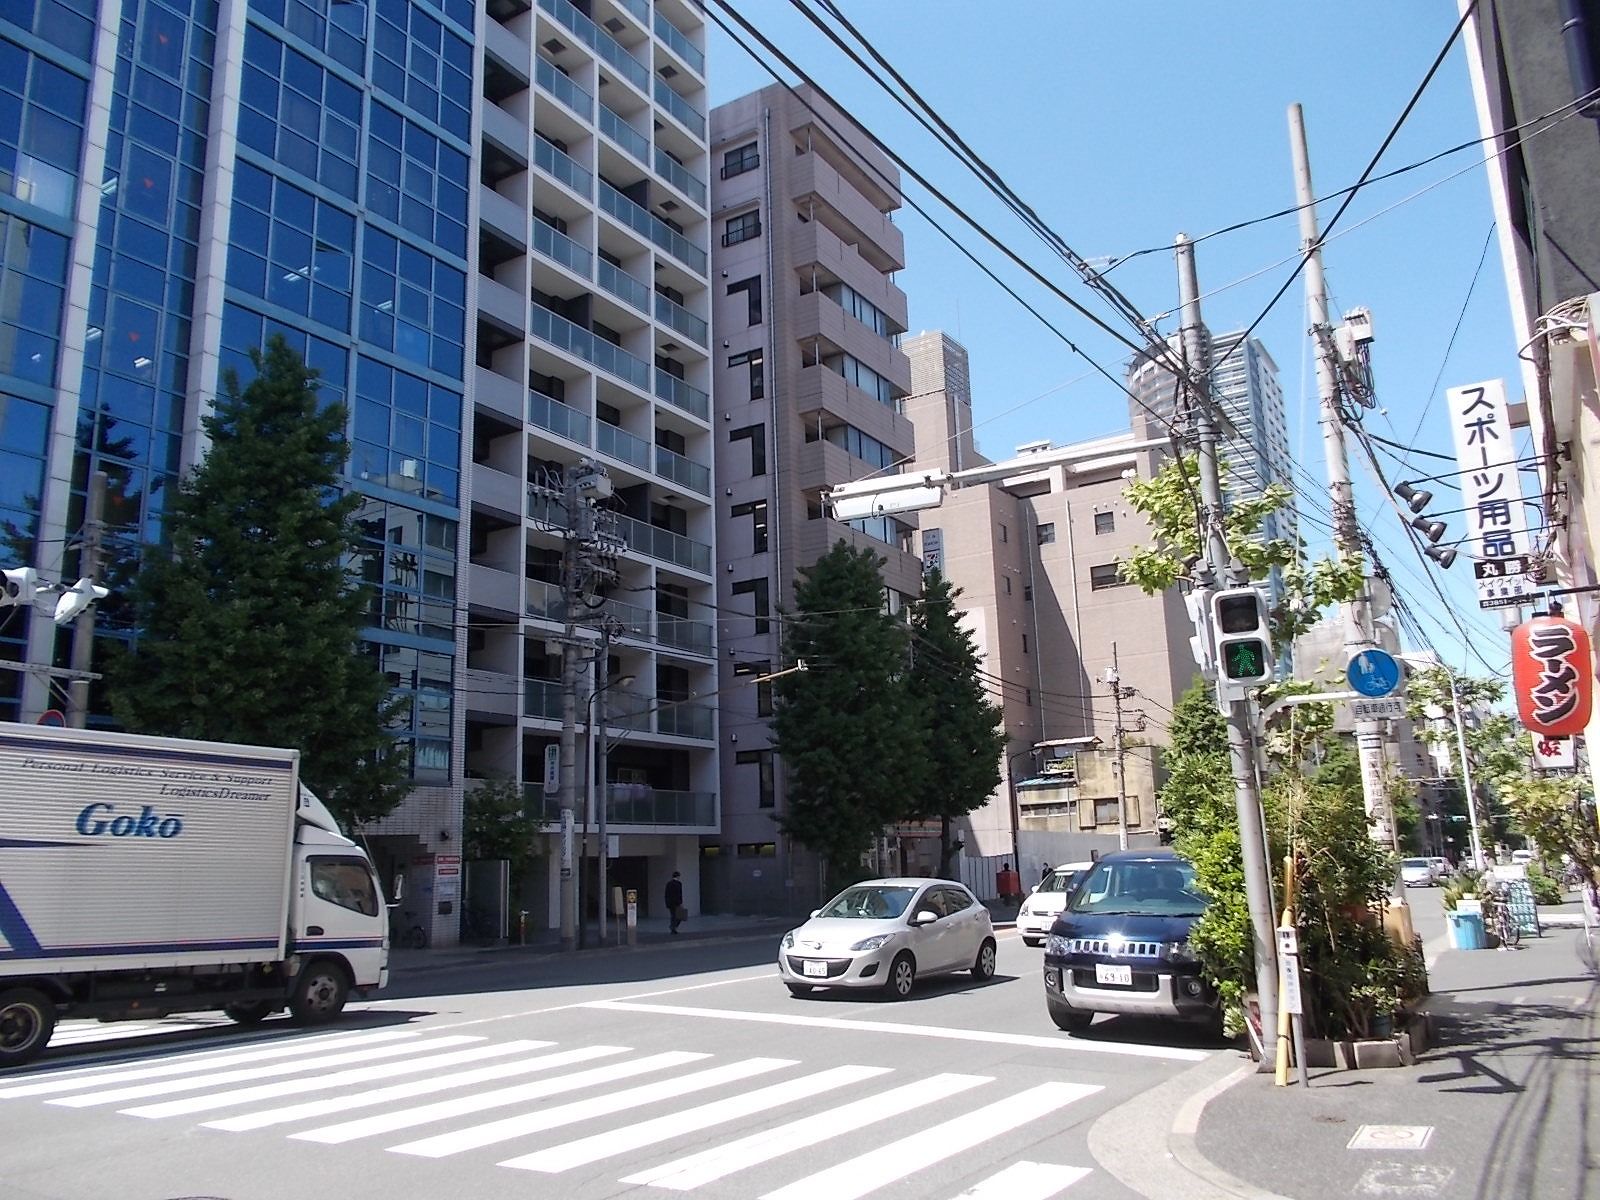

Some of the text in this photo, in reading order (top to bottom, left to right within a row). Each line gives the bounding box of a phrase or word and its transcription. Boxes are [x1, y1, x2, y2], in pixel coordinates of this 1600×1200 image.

[1461, 386, 1516, 557] スポーツ用品
[1530, 626, 1578, 725] ラーメン
[22, 758, 84, 772] Personal
[92, 763, 152, 776] Logistics
[160, 769, 206, 781] Service
[226, 774, 273, 785] Support
[160, 783, 271, 801] LogisticsDreamer
